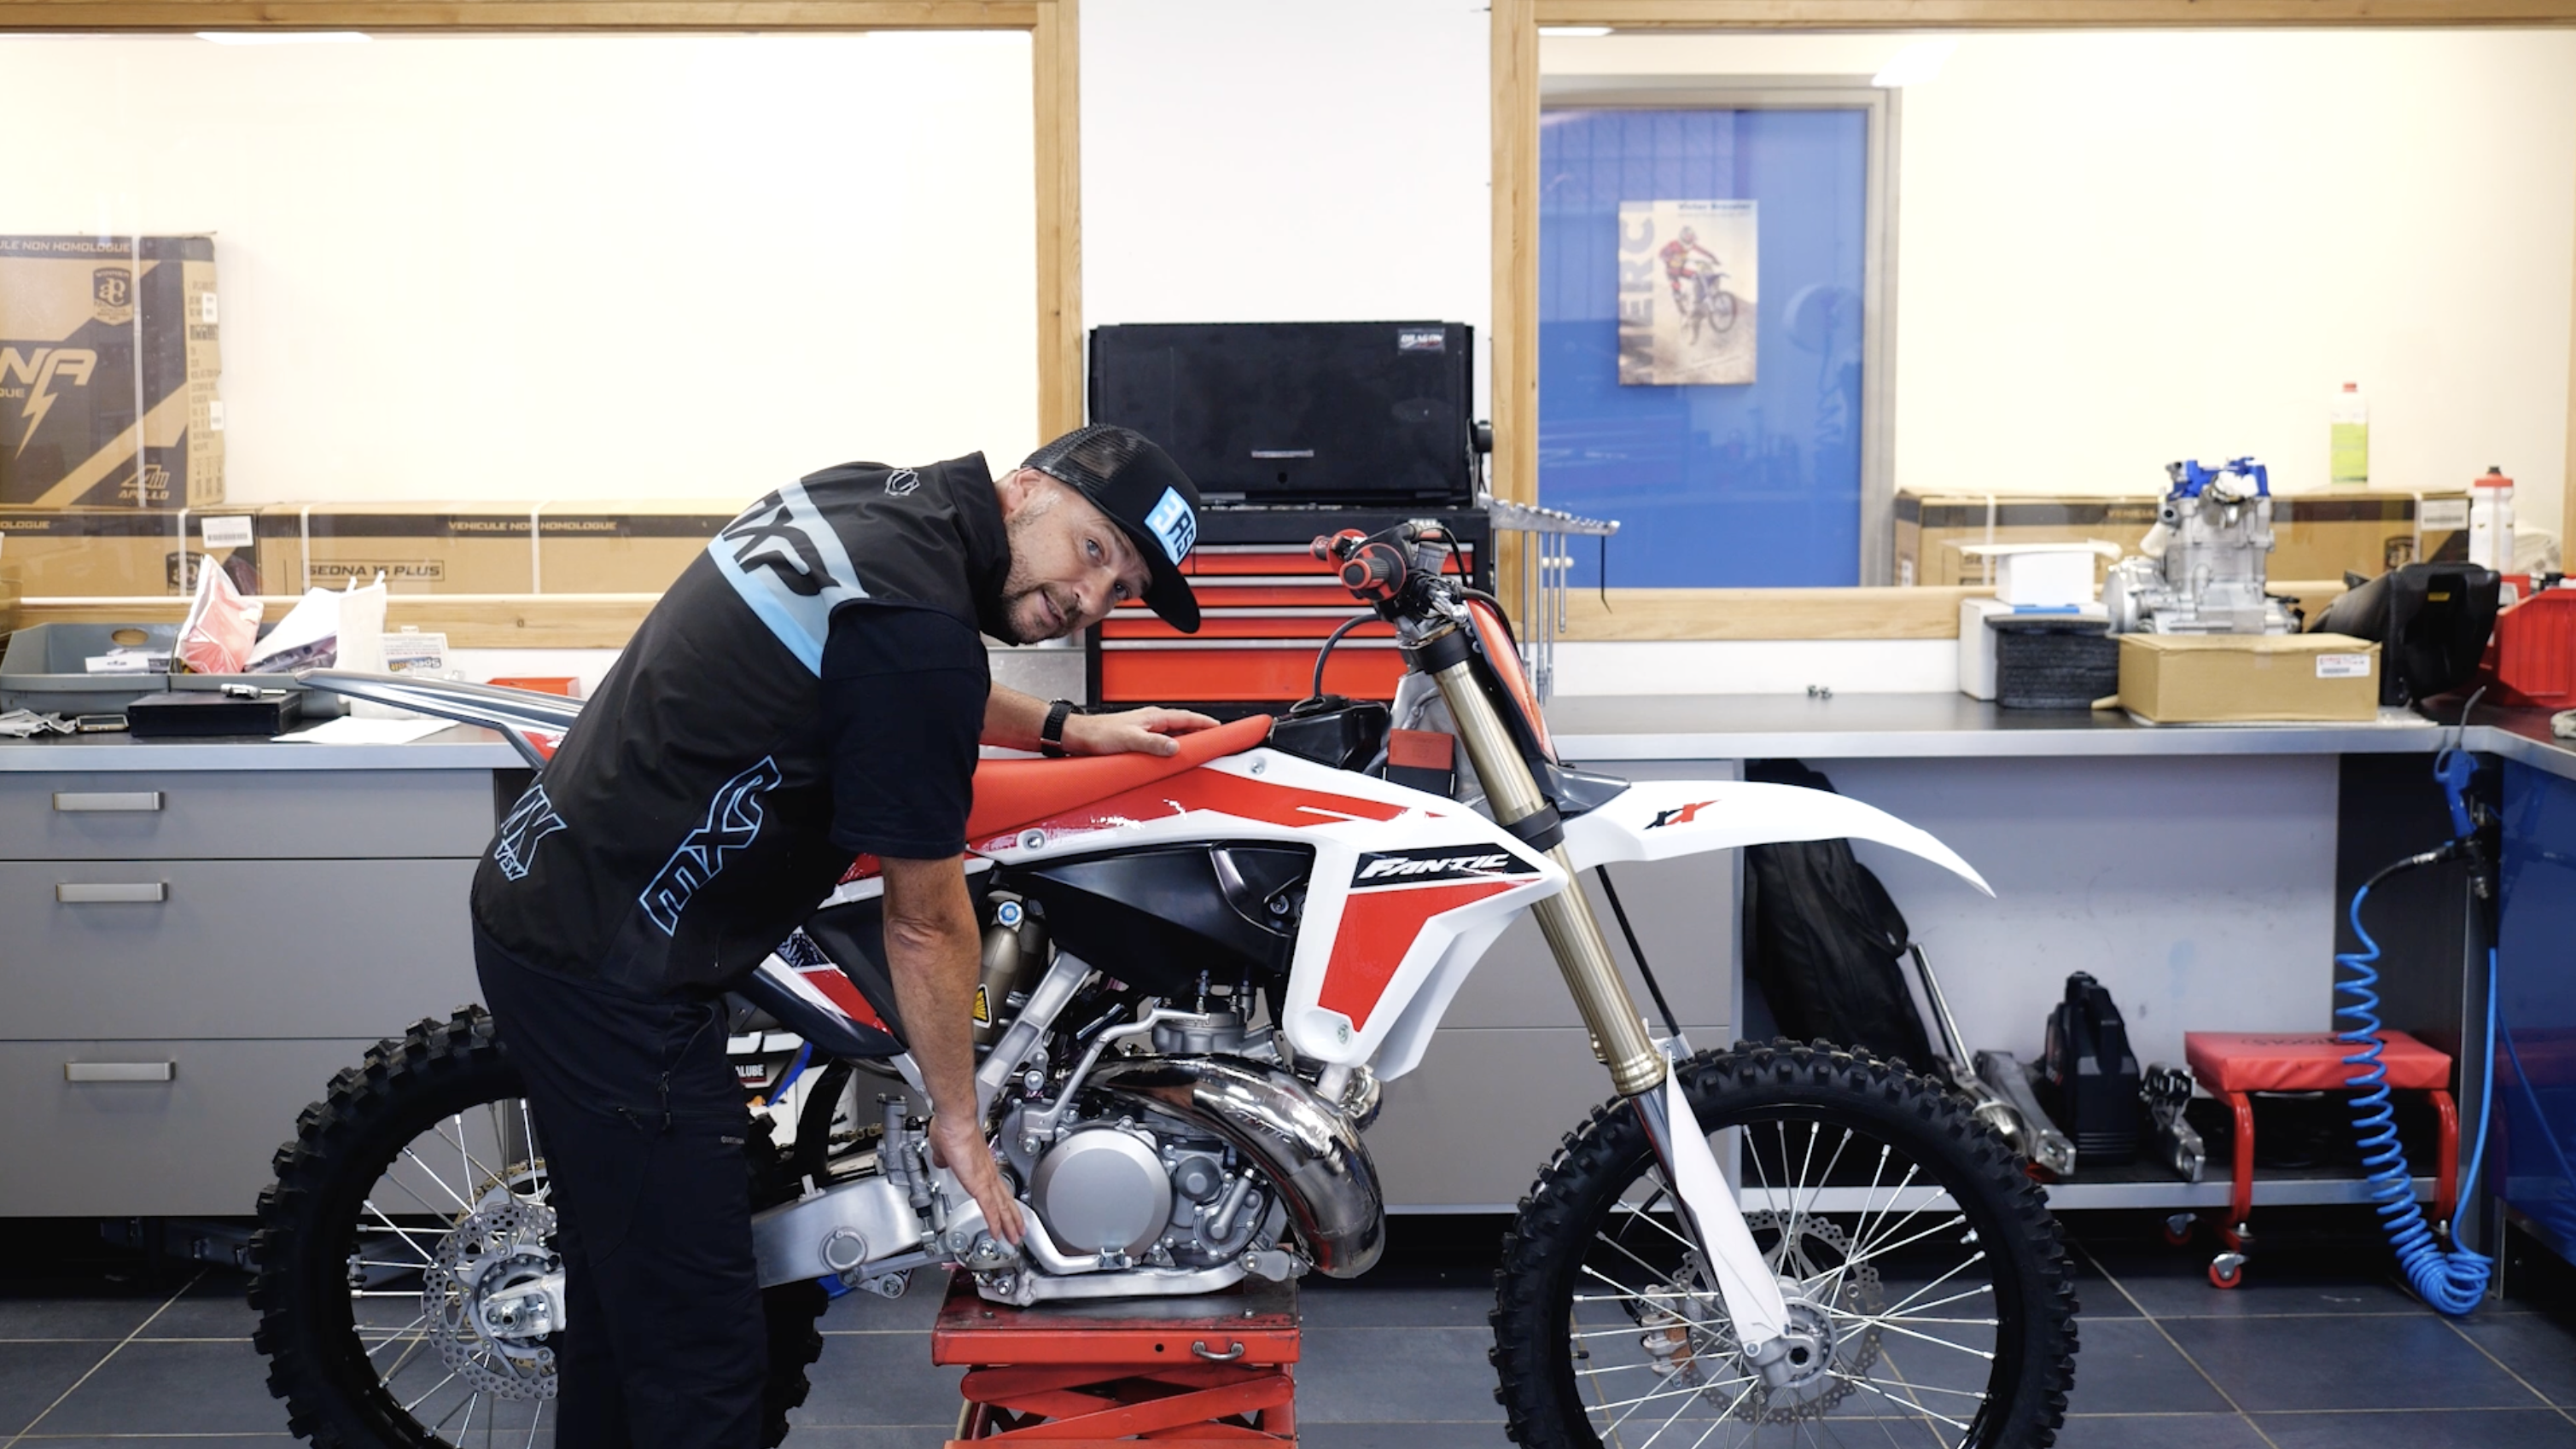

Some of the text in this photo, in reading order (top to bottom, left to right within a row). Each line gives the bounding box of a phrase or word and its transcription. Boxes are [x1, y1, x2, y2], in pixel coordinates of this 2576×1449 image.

[22, 241, 50, 251] NON
[53, 242, 131, 253] HOMOLOGUE
[118, 489, 170, 501] APLLO
[448, 521, 507, 531] VEHICULE
[540, 521, 617, 531] HOMOLOGUE
[309, 564, 367, 576] SEDNA
[393, 565, 440, 576] PLUS
[1357, 853, 1511, 880] FANTIC
